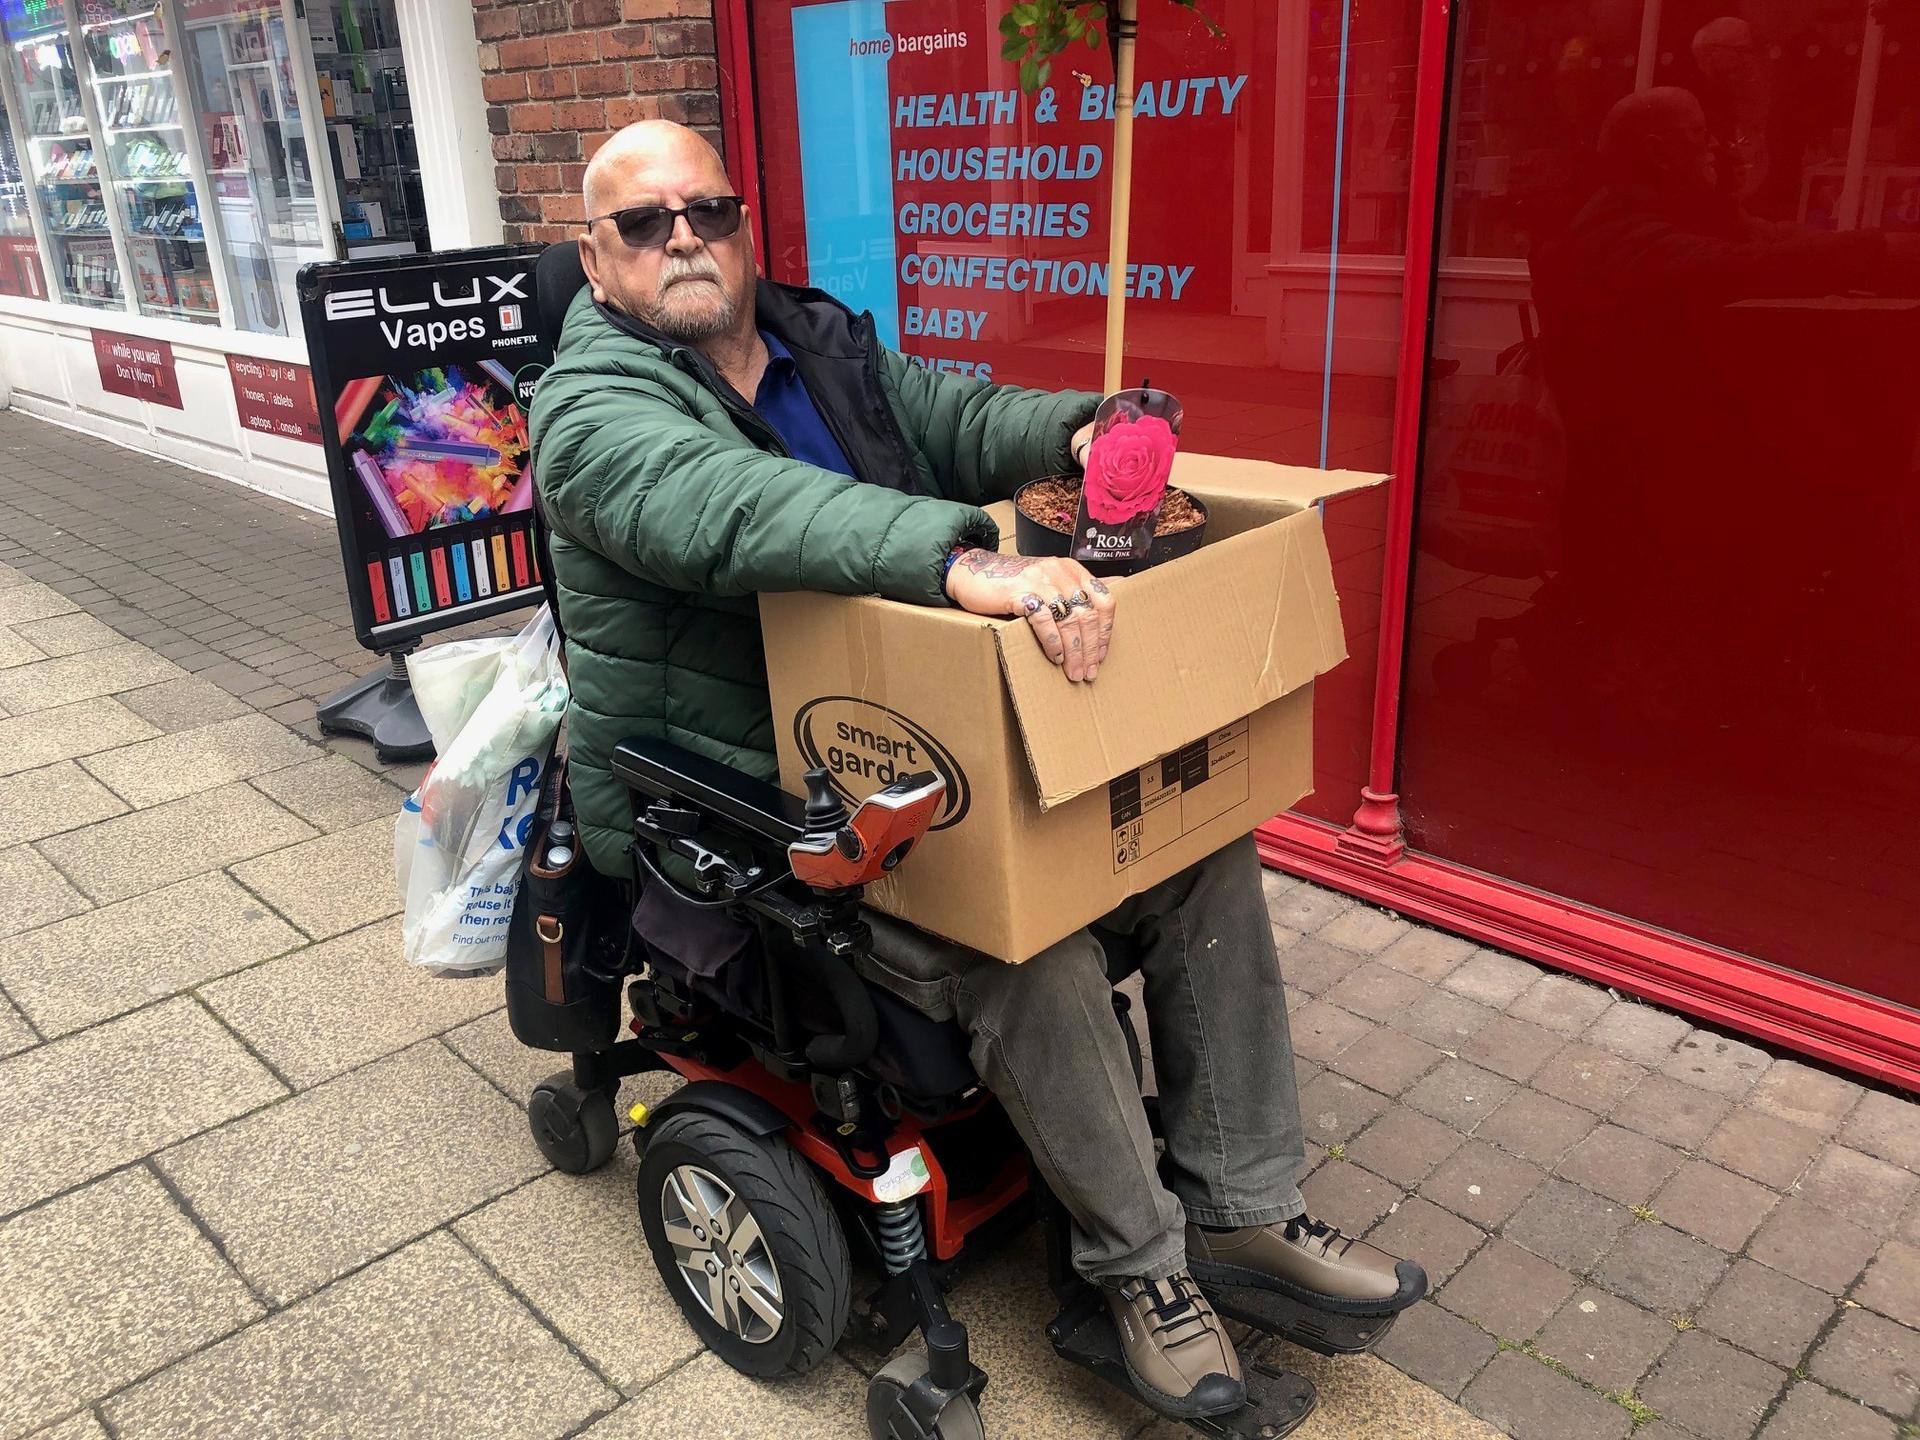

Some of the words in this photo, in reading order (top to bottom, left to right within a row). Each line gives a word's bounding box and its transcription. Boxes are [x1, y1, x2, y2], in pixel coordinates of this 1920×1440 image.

[849, 38, 891, 56] home
[897, 28, 968, 55] bargains
[894, 90, 1017, 128] HEALTH
[1034, 87, 1058, 123] &
[897, 145, 1103, 182] HOUSEHOLD
[899, 202, 1090, 238] GROCERIES
[901, 254, 1195, 301] CONFECTIONERY
[324, 272, 529, 321] ELUX
[379, 316, 486, 352] Vapes
[904, 305, 989, 341] BABY
[112, 342, 131, 359] while
[131, 348, 145, 364] you
[145, 349, 162, 365] wait
[135, 367, 155, 388] Worry
[518, 379, 538, 388] AVAILA
[519, 386, 536, 399] NO
[1096, 534, 1133, 548] ROSA
[1114, 550, 1131, 558] PINK
[836, 721, 917, 765] smart
[827, 746, 911, 786] gard
[460, 913, 490, 926] Then
[493, 915, 512, 925] rec
[466, 900, 501, 911] Reuse
[452, 933, 473, 945] Find
[475, 936, 490, 945] out
